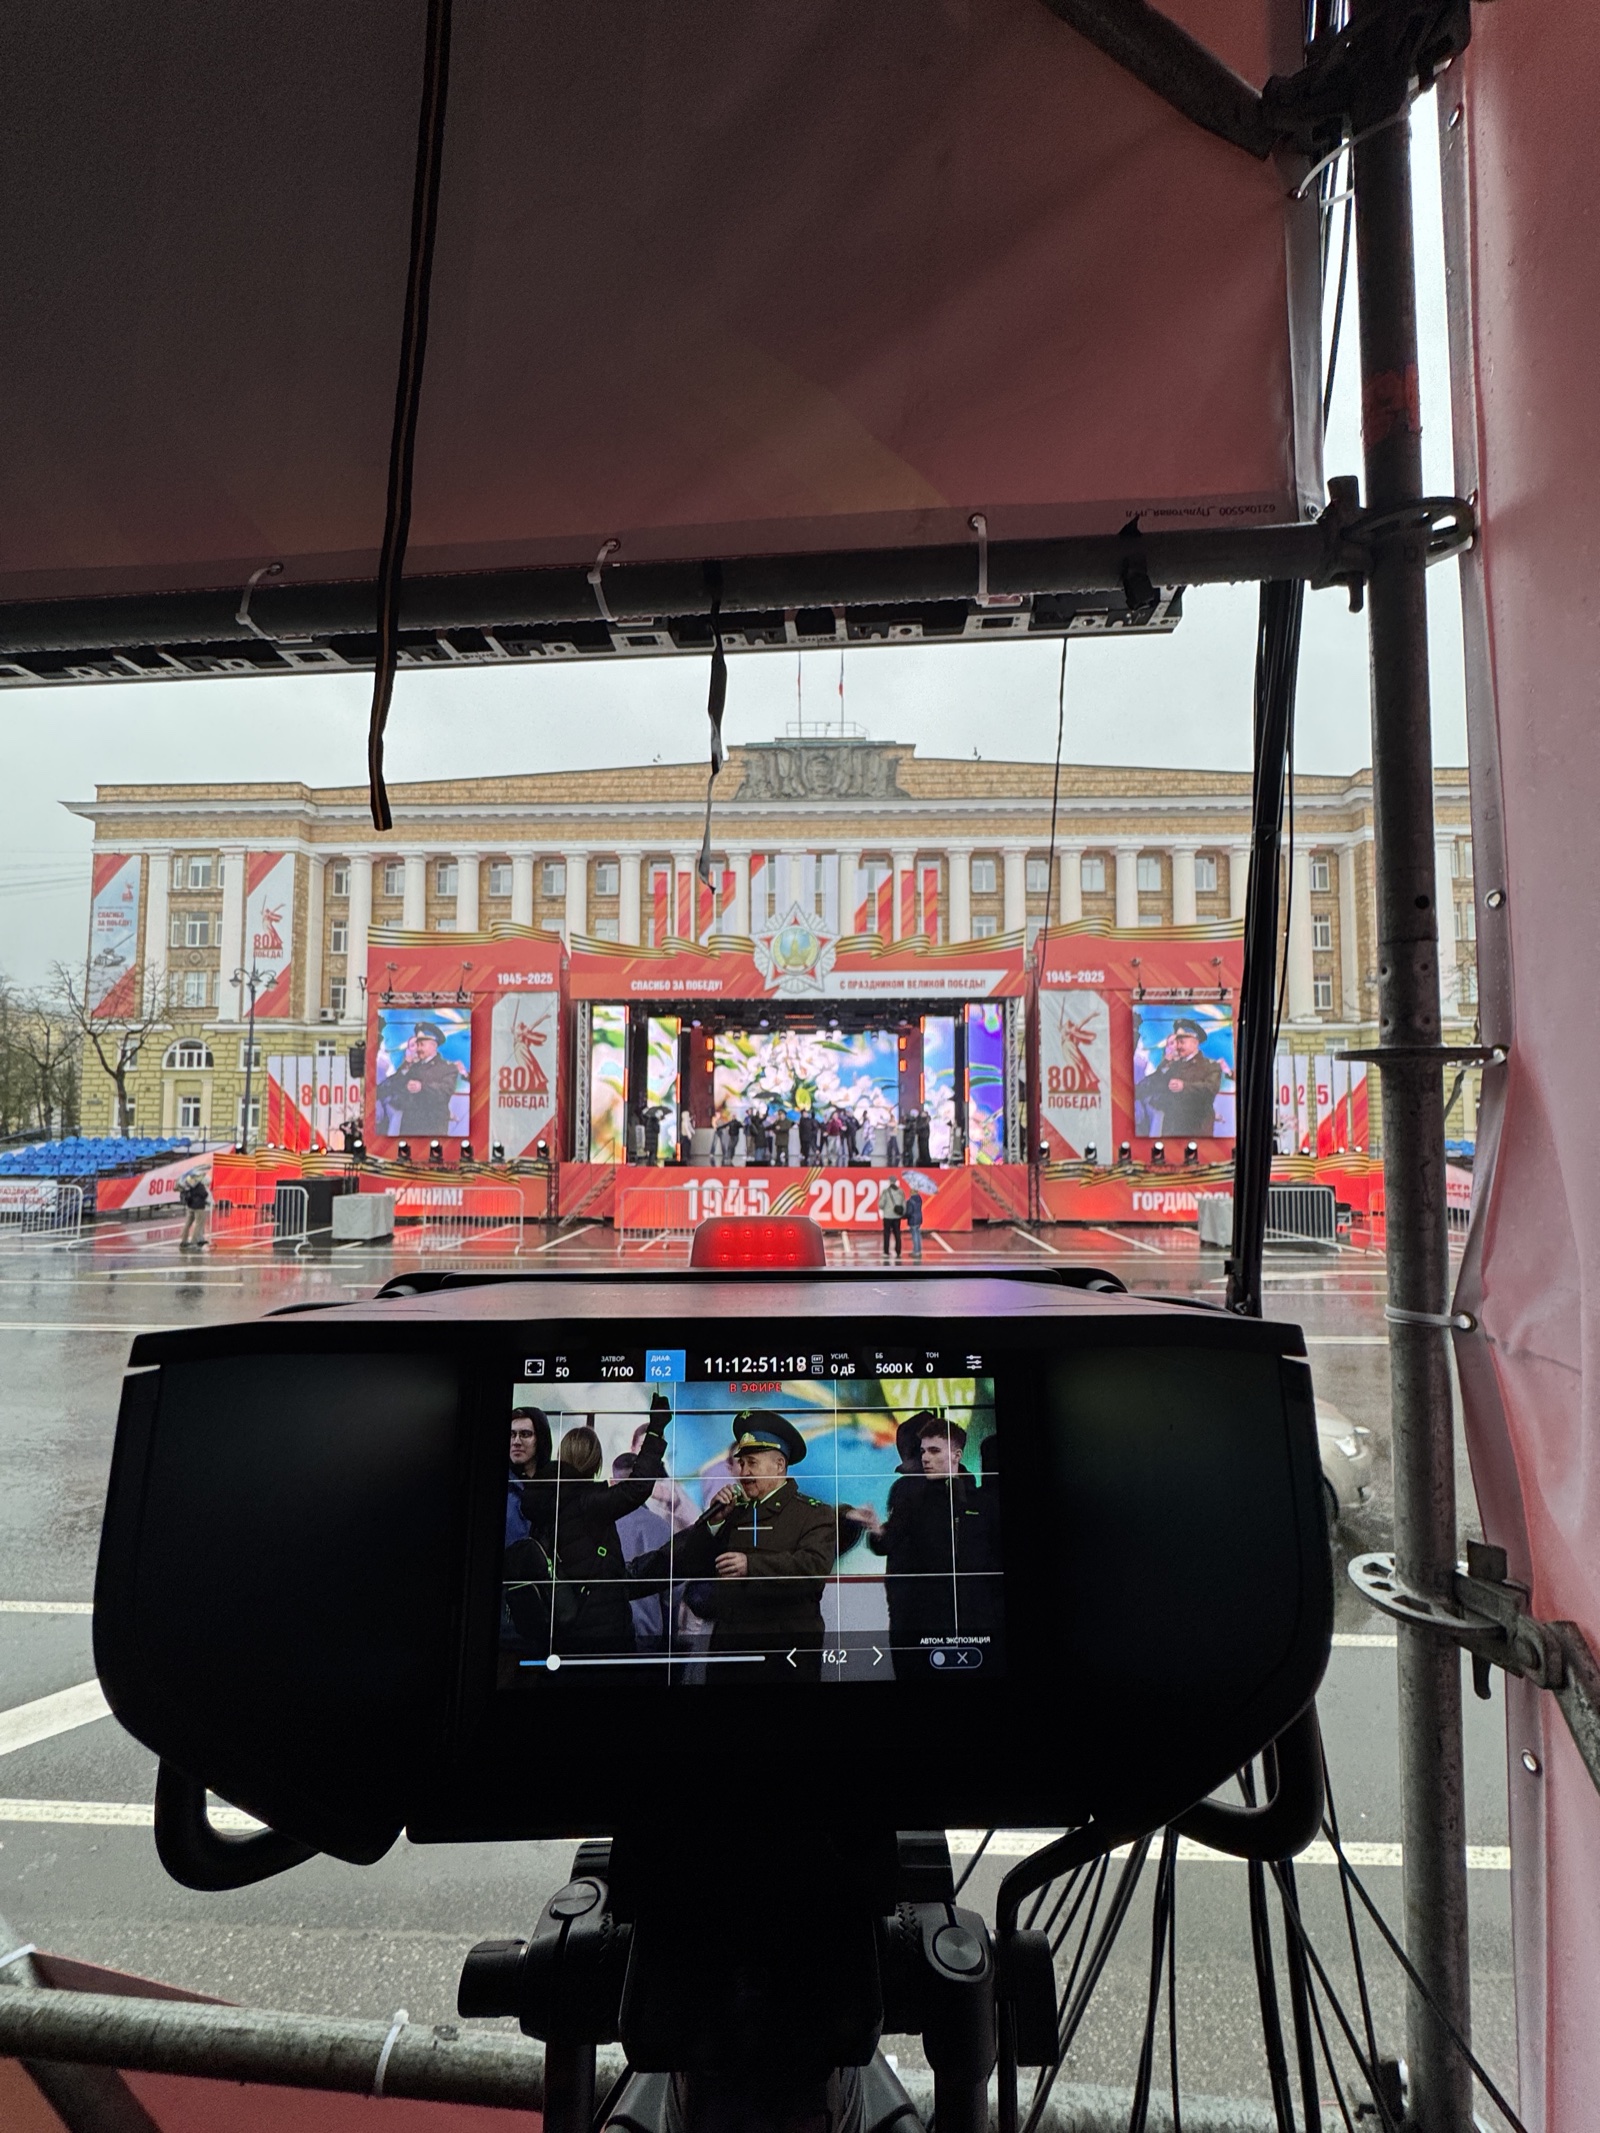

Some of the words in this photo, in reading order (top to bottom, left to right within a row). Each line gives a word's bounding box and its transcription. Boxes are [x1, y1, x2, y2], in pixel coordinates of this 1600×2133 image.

[253, 933, 270, 948] 80
[630, 979, 671, 991] СПАСИБО
[672, 979, 684, 991] ЗА
[685, 979, 723, 992] ПОБЕДУ!
[840, 980, 846, 990] С
[847, 980, 905, 990] ПРАЗДНИКОМ
[907, 978, 945, 989] ВЕЛИКОЙ
[947, 979, 986, 990] ПОБЕДЫ!
[498, 1066, 527, 1092] 80
[1047, 1065, 1077, 1091] 80
[498, 1095, 550, 1110] ПОБЕДА!
[1047, 1094, 1102, 1110] ПОБЕДА!
[148, 1178, 164, 1197] 80
[683, 1178, 770, 1221] 1945
[809, 1178, 901, 1222] 202
[600, 1355, 625, 1363] ЗАТВОР
[704, 1356, 807, 1374] 11:12:51:18
[555, 1367, 570, 1377] 50
[601, 1366, 634, 1378] 1/100
[651, 1366, 671, 1377] f6,2
[830, 1364, 839, 1375] 0
[840, 1363, 856, 1376] дБ
[875, 1363, 902, 1374] 5600
[926, 1362, 934, 1374] 0
[729, 1383, 737, 1393] В
[741, 1381, 783, 1393] ЭФИРЕ
[920, 1637, 945, 1645] АВТОМ.
[946, 1636, 991, 1645] ЭКСПОЗИЦИЯ
[822, 1649, 848, 1665] f6,2
